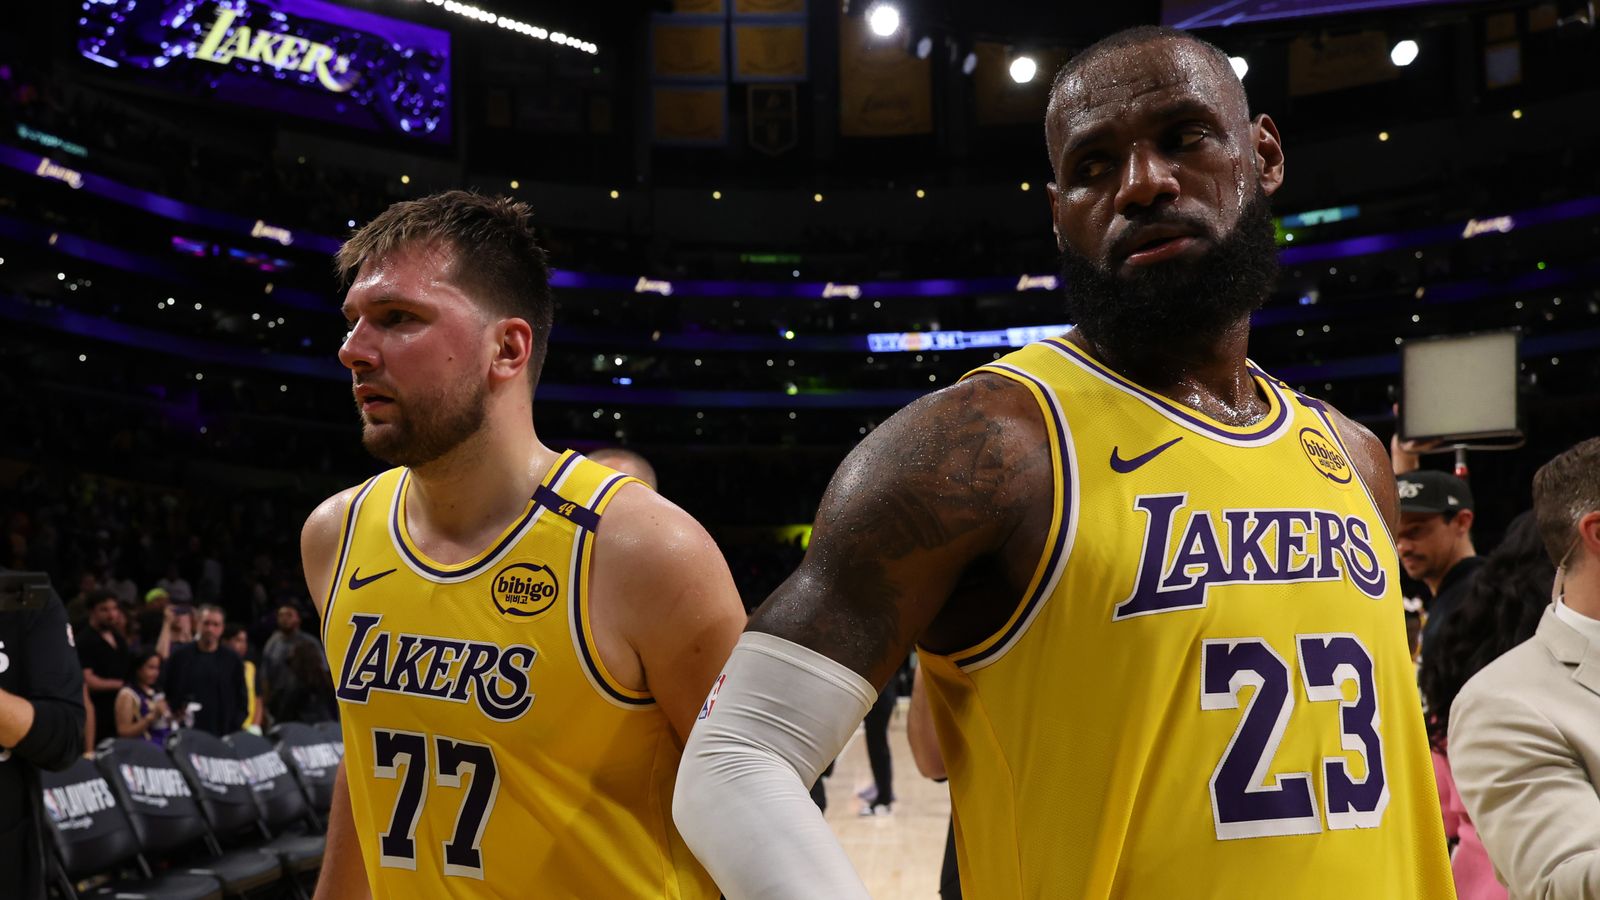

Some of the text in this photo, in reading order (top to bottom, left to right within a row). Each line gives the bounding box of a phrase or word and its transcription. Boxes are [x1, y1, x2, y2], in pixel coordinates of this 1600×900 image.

[1303, 438, 1345, 469] bibigo
[558, 502, 577, 517] 44
[497, 576, 555, 602] bibigo
[1112, 491, 1387, 622] LAKERS
[505, 594, 528, 605] 비비고
[336, 613, 539, 722] LAKERS
[1199, 632, 1391, 841] 23
[371, 727, 500, 881] 77
